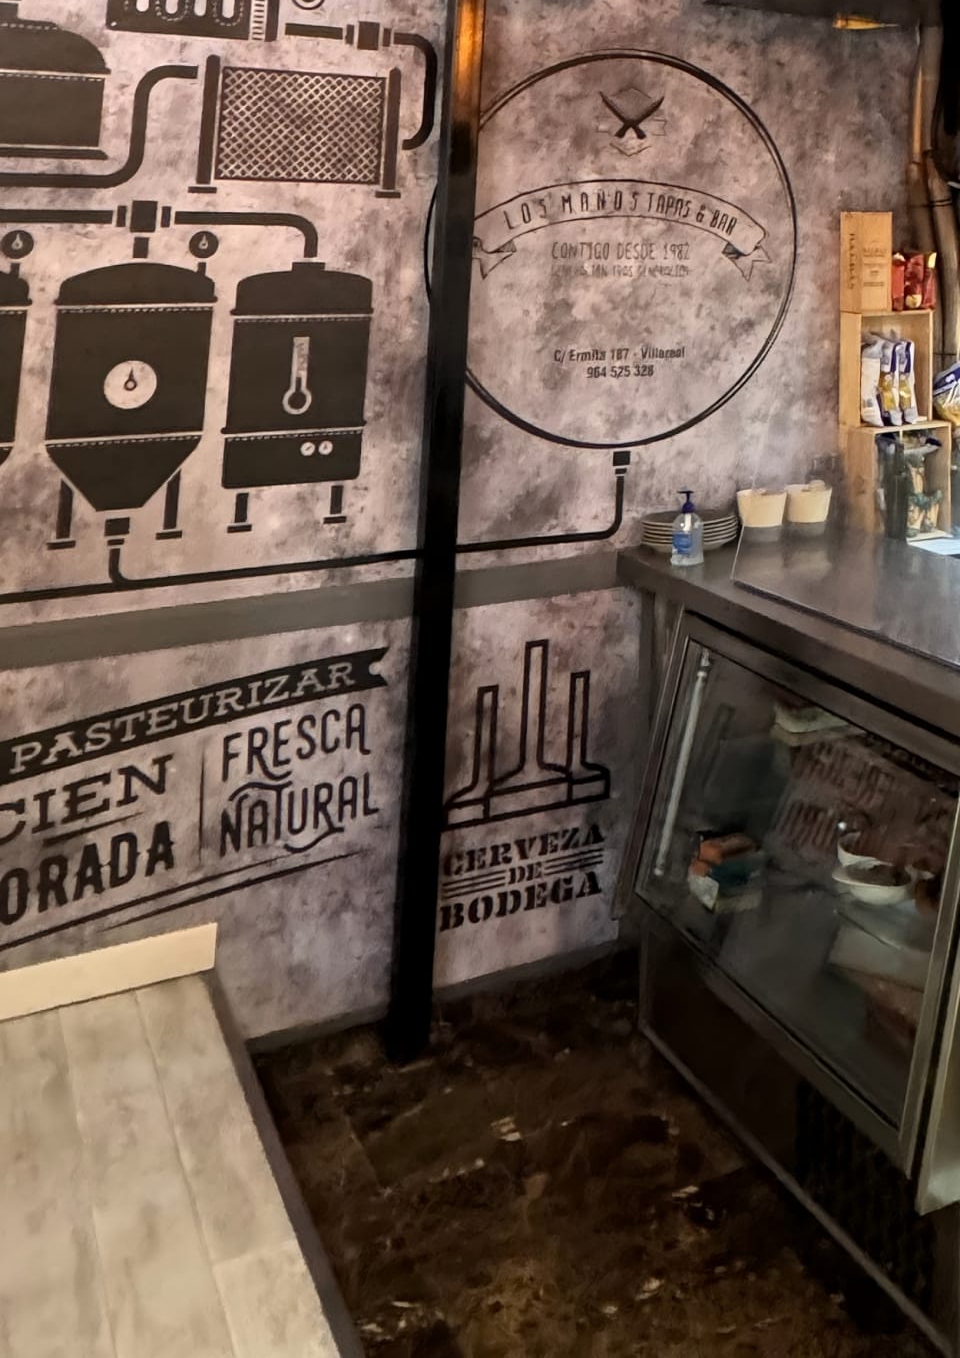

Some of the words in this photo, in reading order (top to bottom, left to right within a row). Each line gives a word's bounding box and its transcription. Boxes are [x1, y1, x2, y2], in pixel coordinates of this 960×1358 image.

[503, 197, 548, 230] LOS
[648, 191, 693, 218] TAPAS
[709, 208, 738, 237] BAR
[551, 241, 610, 260] CONTIGO
[616, 241, 656, 260] DESDE
[586, 366, 607, 379] 964
[610, 365, 631, 379] 525
[9, 662, 356, 775] PASTEURIZAR
[222, 703, 371, 783] FRESCA
[220, 771, 381, 859] NATURAL
[0, 820, 175, 926] ORADA
[443, 823, 605, 877] CERVEZA
[508, 861, 542, 885] DE
[439, 871, 602, 932] BODEGA
